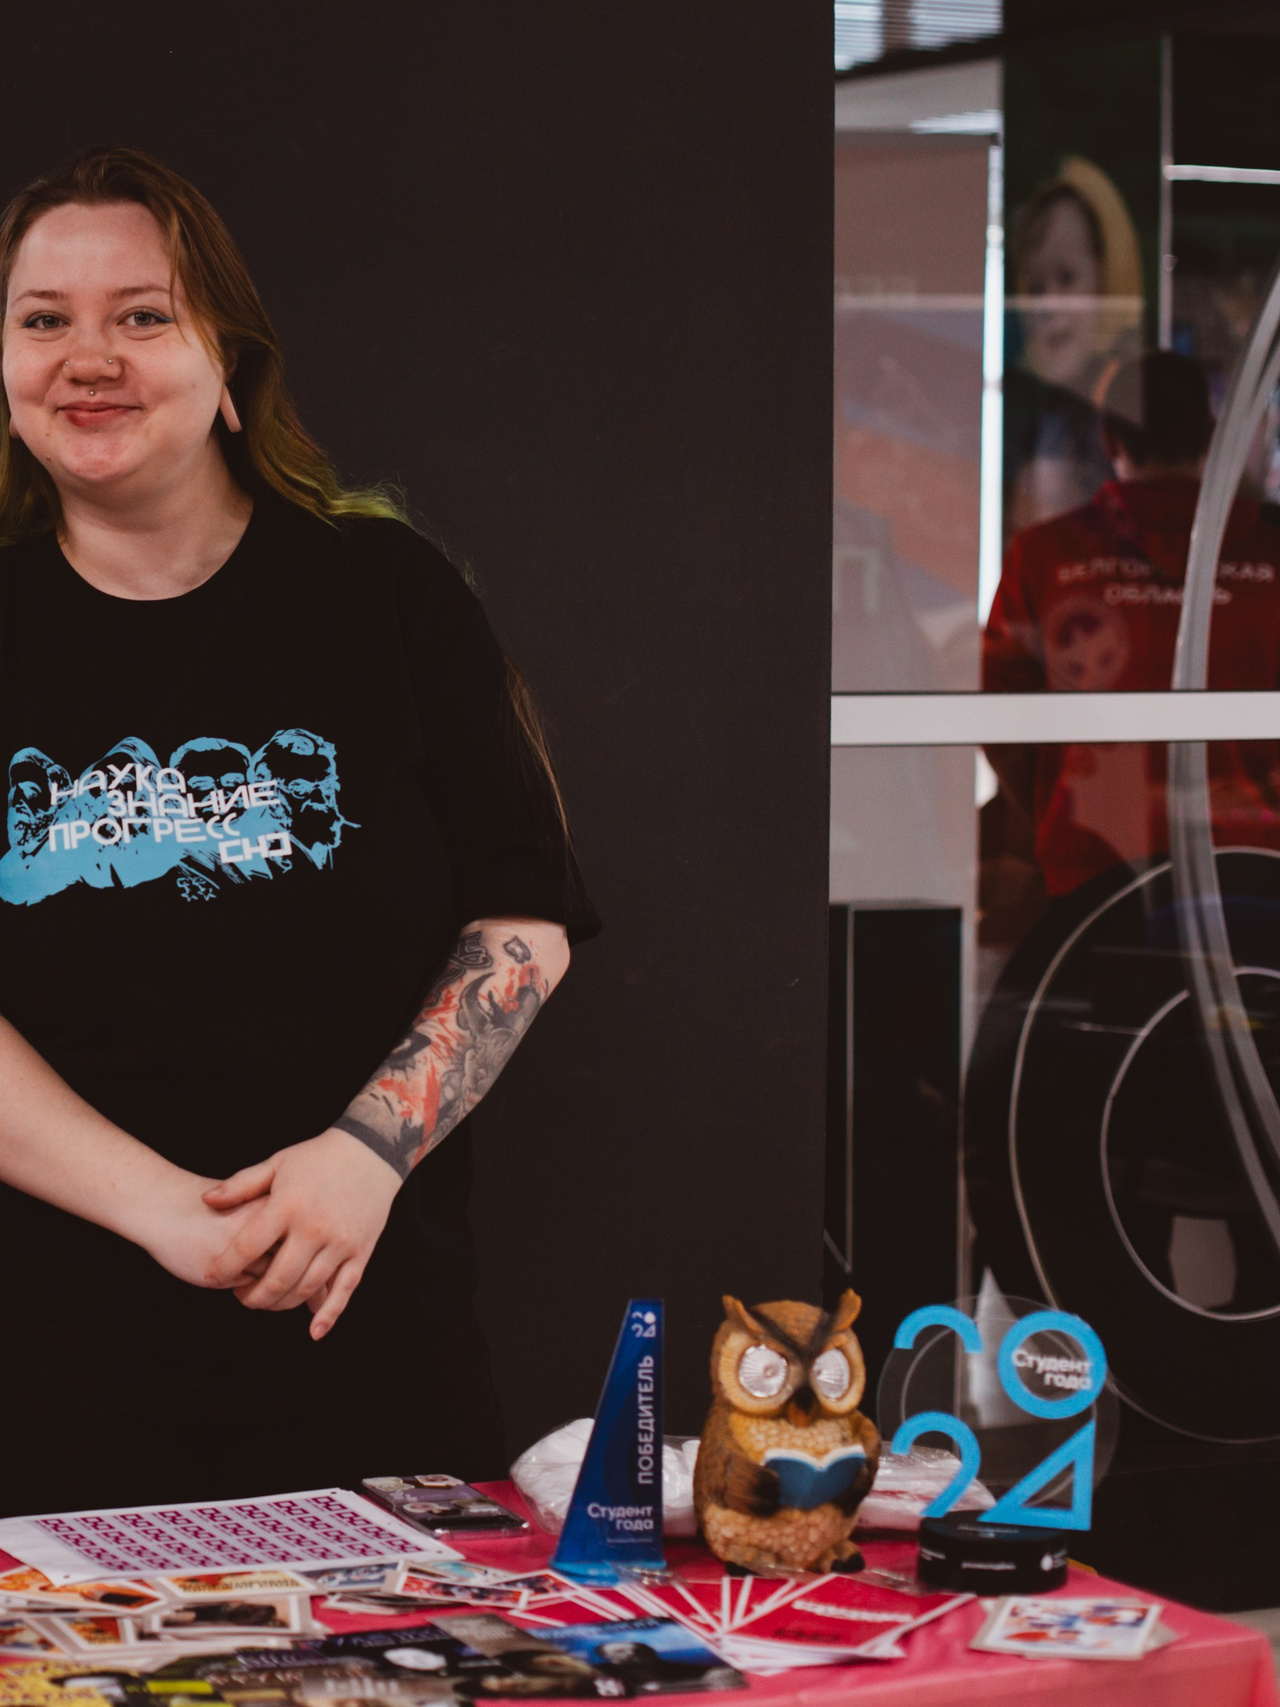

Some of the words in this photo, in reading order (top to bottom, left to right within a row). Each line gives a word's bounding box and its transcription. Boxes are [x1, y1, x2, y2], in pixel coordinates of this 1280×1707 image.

[50, 762, 187, 806] НАУКА
[106, 780, 281, 818] ЗНАНИЕ
[48, 812, 241, 852] ПРОГРЕСС
[1011, 1348, 1093, 1375] Студент
[1043, 1372, 1094, 1391] года
[637, 1355, 656, 1485] ПОБЕДИТЕЛЬ
[586, 1502, 654, 1522] Студент
[615, 1518, 654, 1531] года
